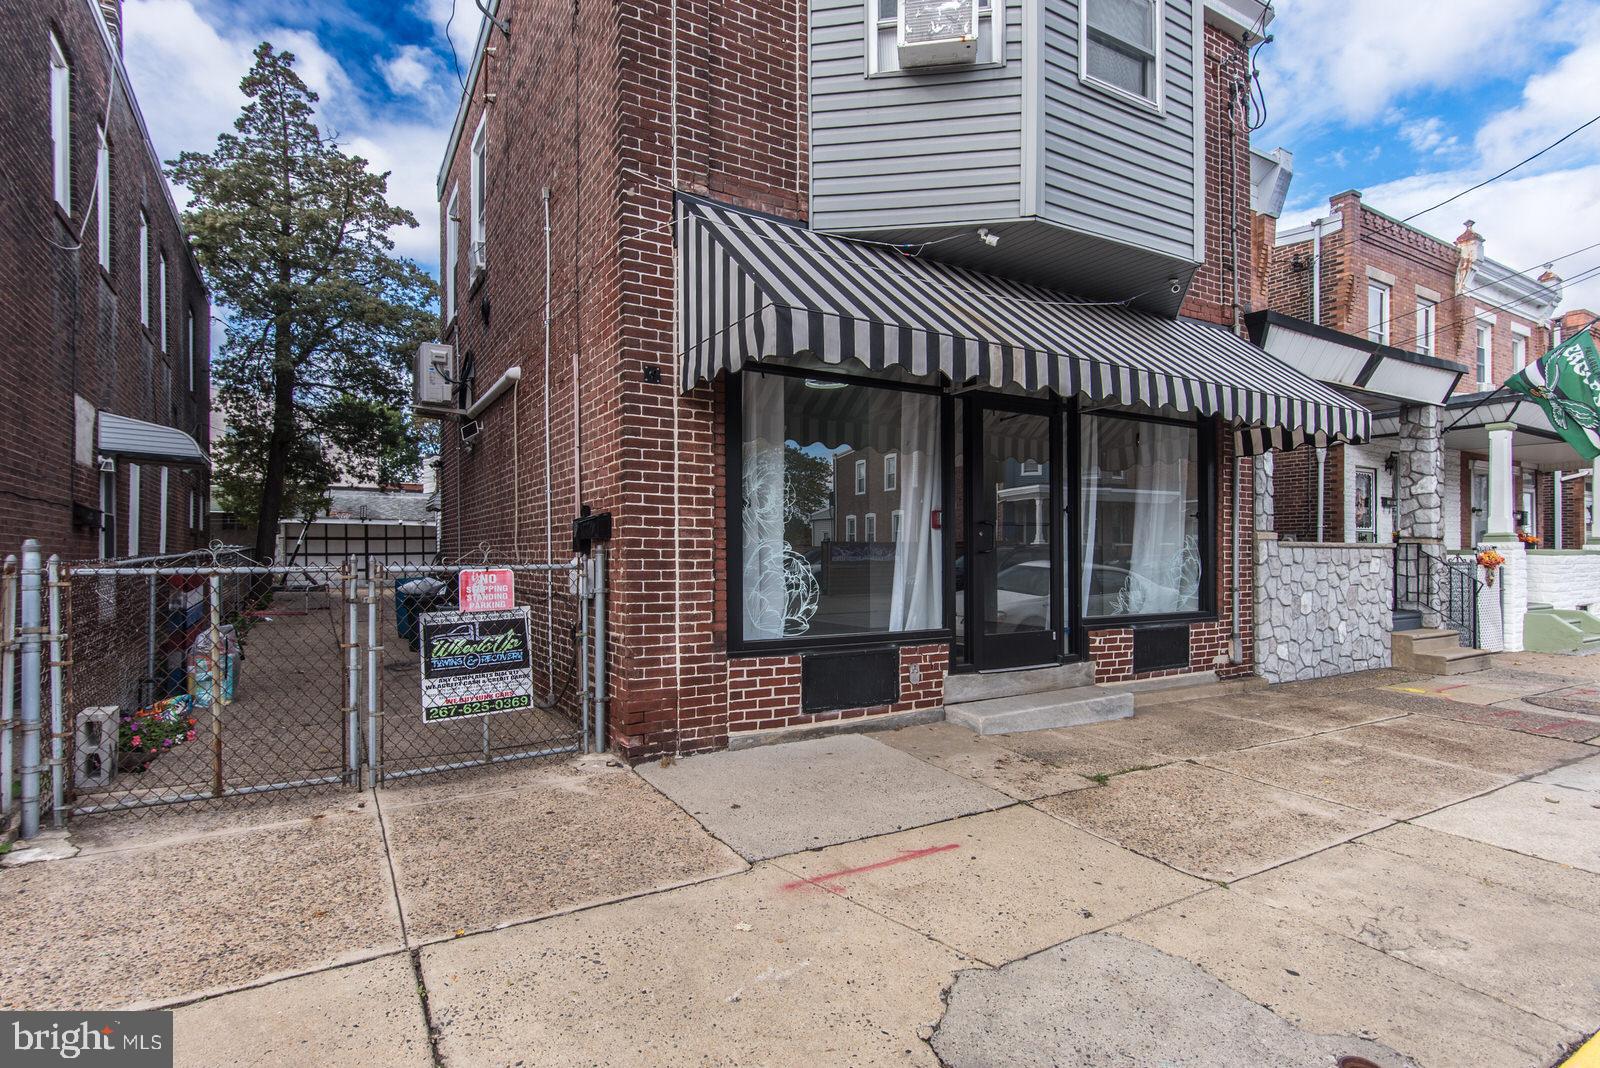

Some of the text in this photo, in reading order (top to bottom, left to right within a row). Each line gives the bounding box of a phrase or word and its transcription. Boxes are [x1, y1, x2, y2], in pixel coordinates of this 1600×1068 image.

[480, 574, 497, 585] NO
[466, 585, 508, 594] SPPING
[466, 593, 508, 601] STANDING
[469, 601, 506, 609] PARKING
[430, 696, 528, 719] 267-625-0369
